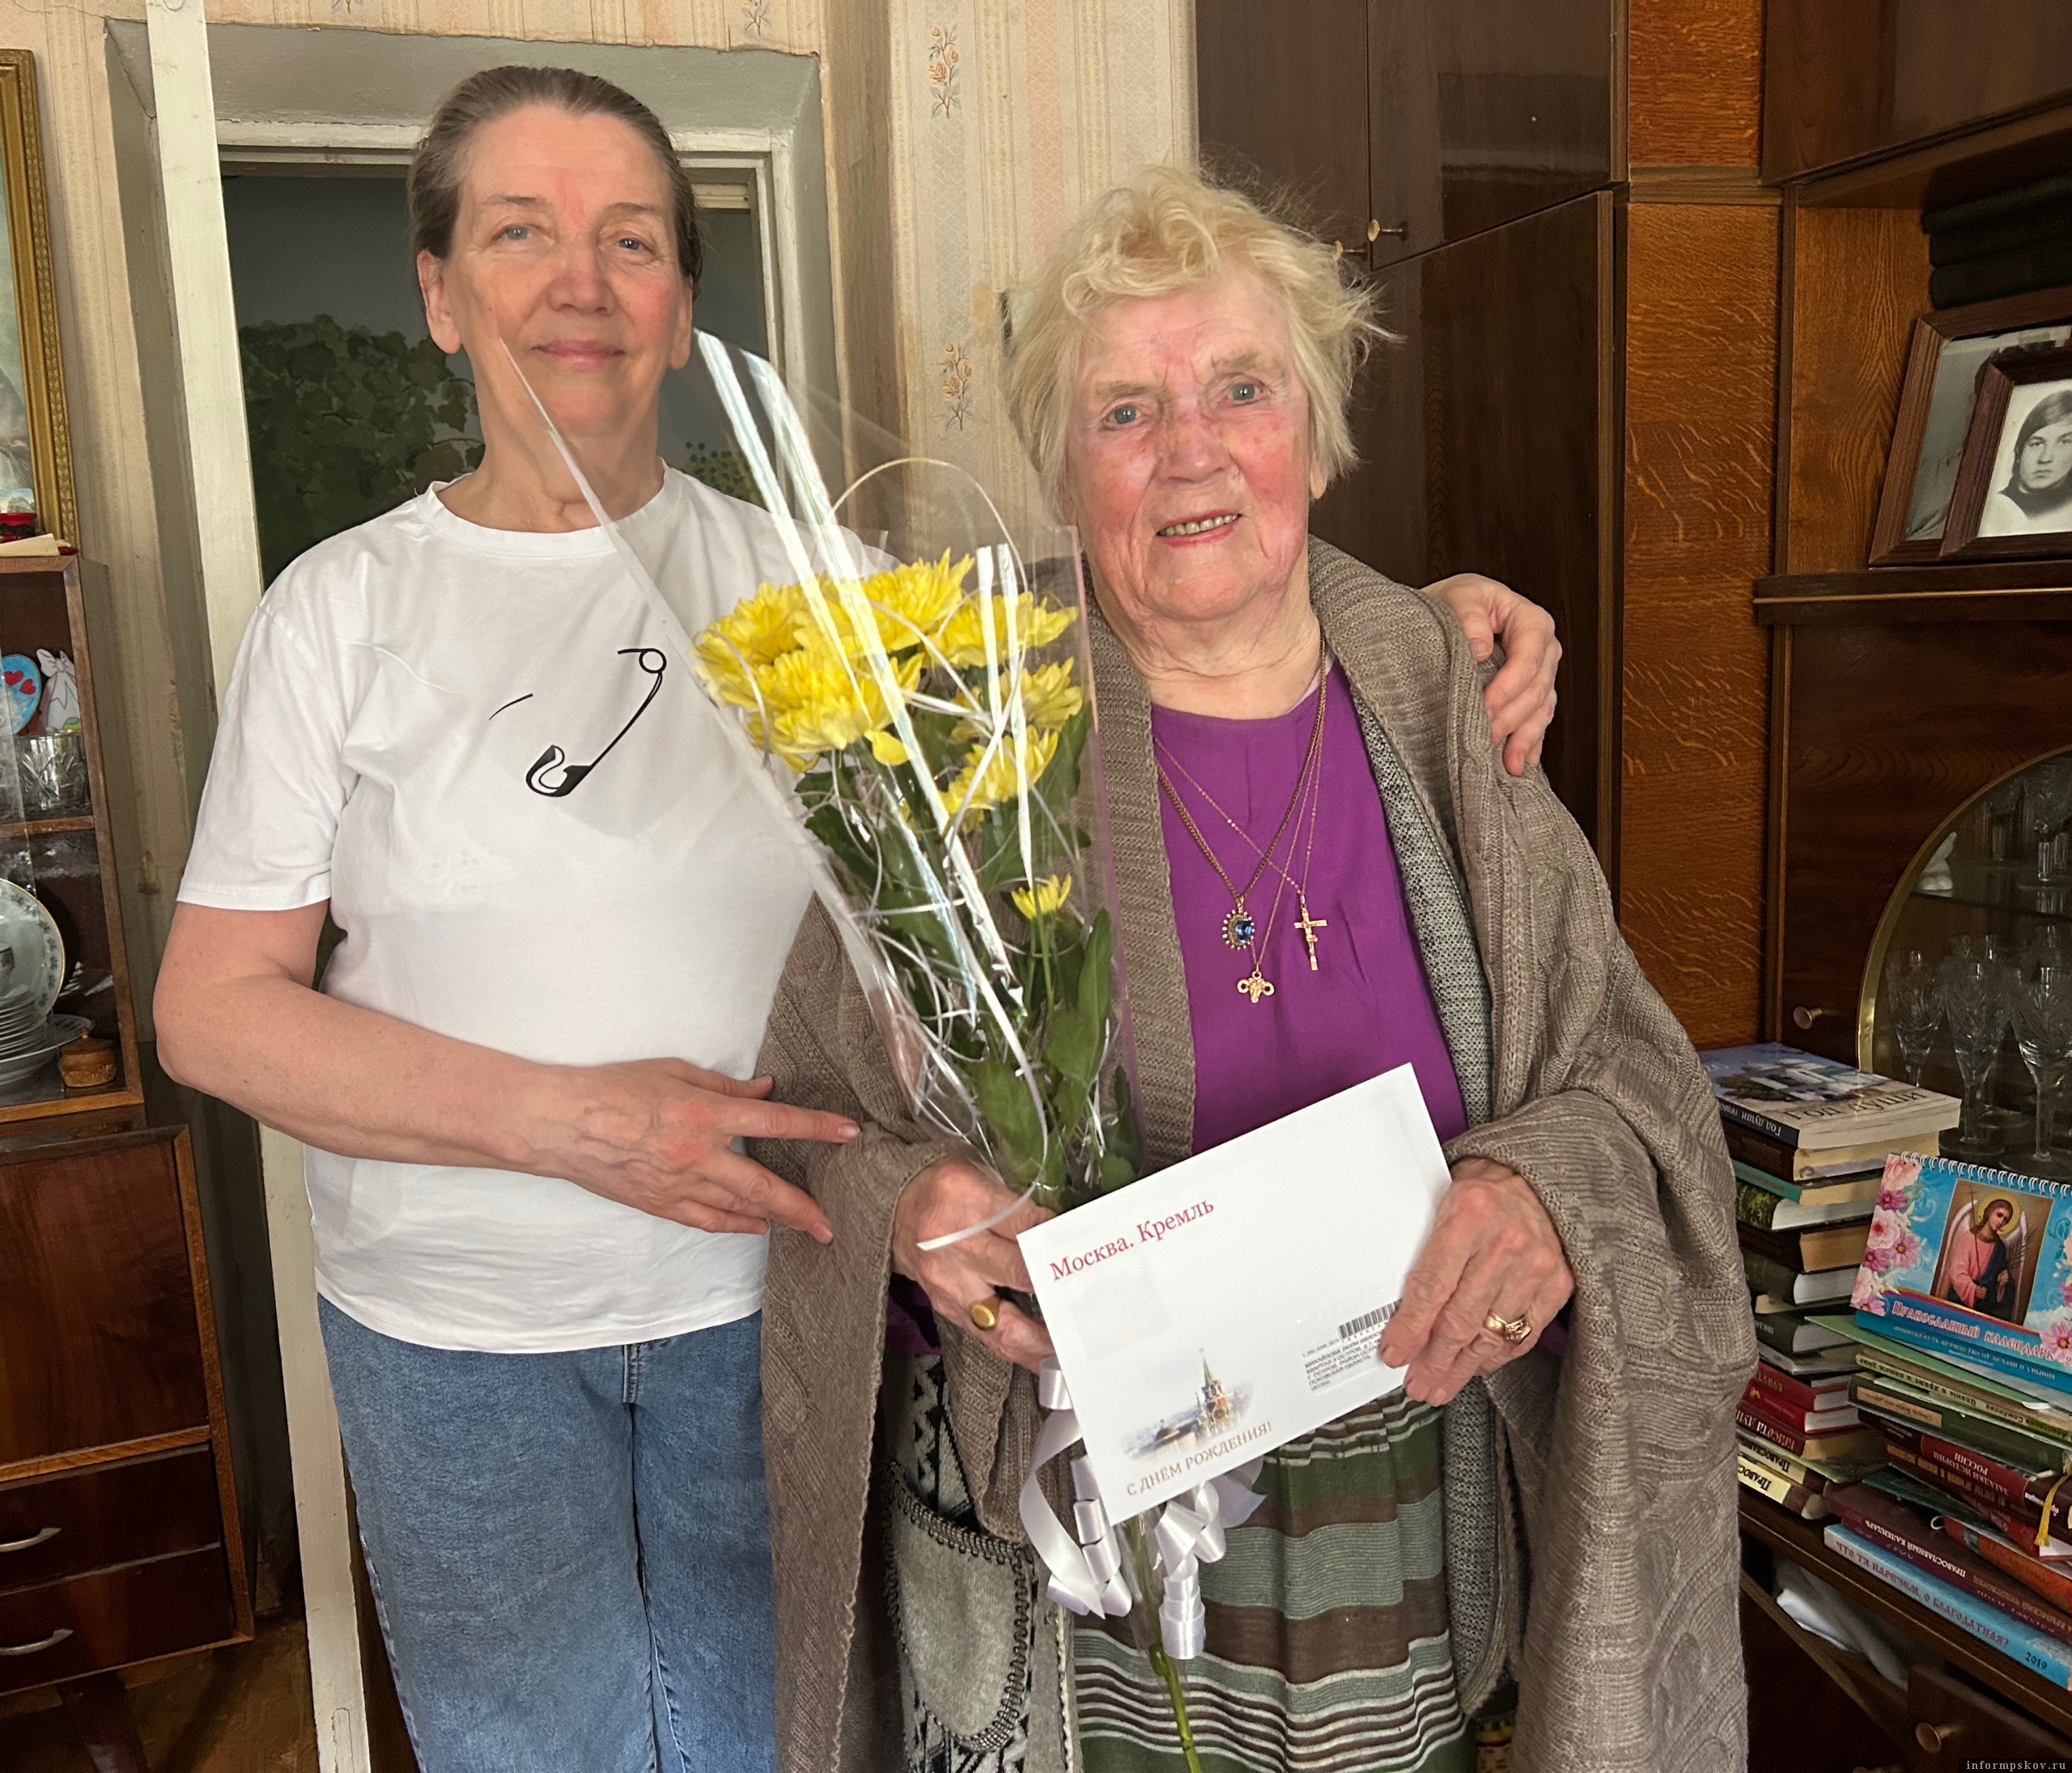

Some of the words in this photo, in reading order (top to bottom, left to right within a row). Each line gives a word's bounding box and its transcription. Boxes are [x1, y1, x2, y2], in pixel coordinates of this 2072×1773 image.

[1783, 1107, 1841, 1120] ГОД
[1850, 1092, 1926, 1112] ДУШИ
[1741, 1110, 1764, 1127] души
[1764, 1120, 1781, 1136] Год
[1049, 1237, 1134, 1282] Москва.
[1136, 1200, 1214, 1242] Кремль
[1754, 1421, 1795, 1450] КРАСОТА
[1140, 1463, 1182, 1494] ДНЁМ
[1185, 1421, 1272, 1470] РОЖДЕНИЯ!
[1932, 1451, 1971, 1475] ИСТОРИИ
[1953, 1452, 1989, 1474] РОССИИ
[1971, 1471, 2009, 1495] ЗАГАДКИ
[1863, 1519, 1907, 1546] КАЛЕНДАРЬ
[1833, 1541, 1855, 1558] ЧТО
[1905, 1541, 1967, 1577] ПРАВОСЛАВНЫЙ
[2023, 1651, 2049, 1670] 2019
